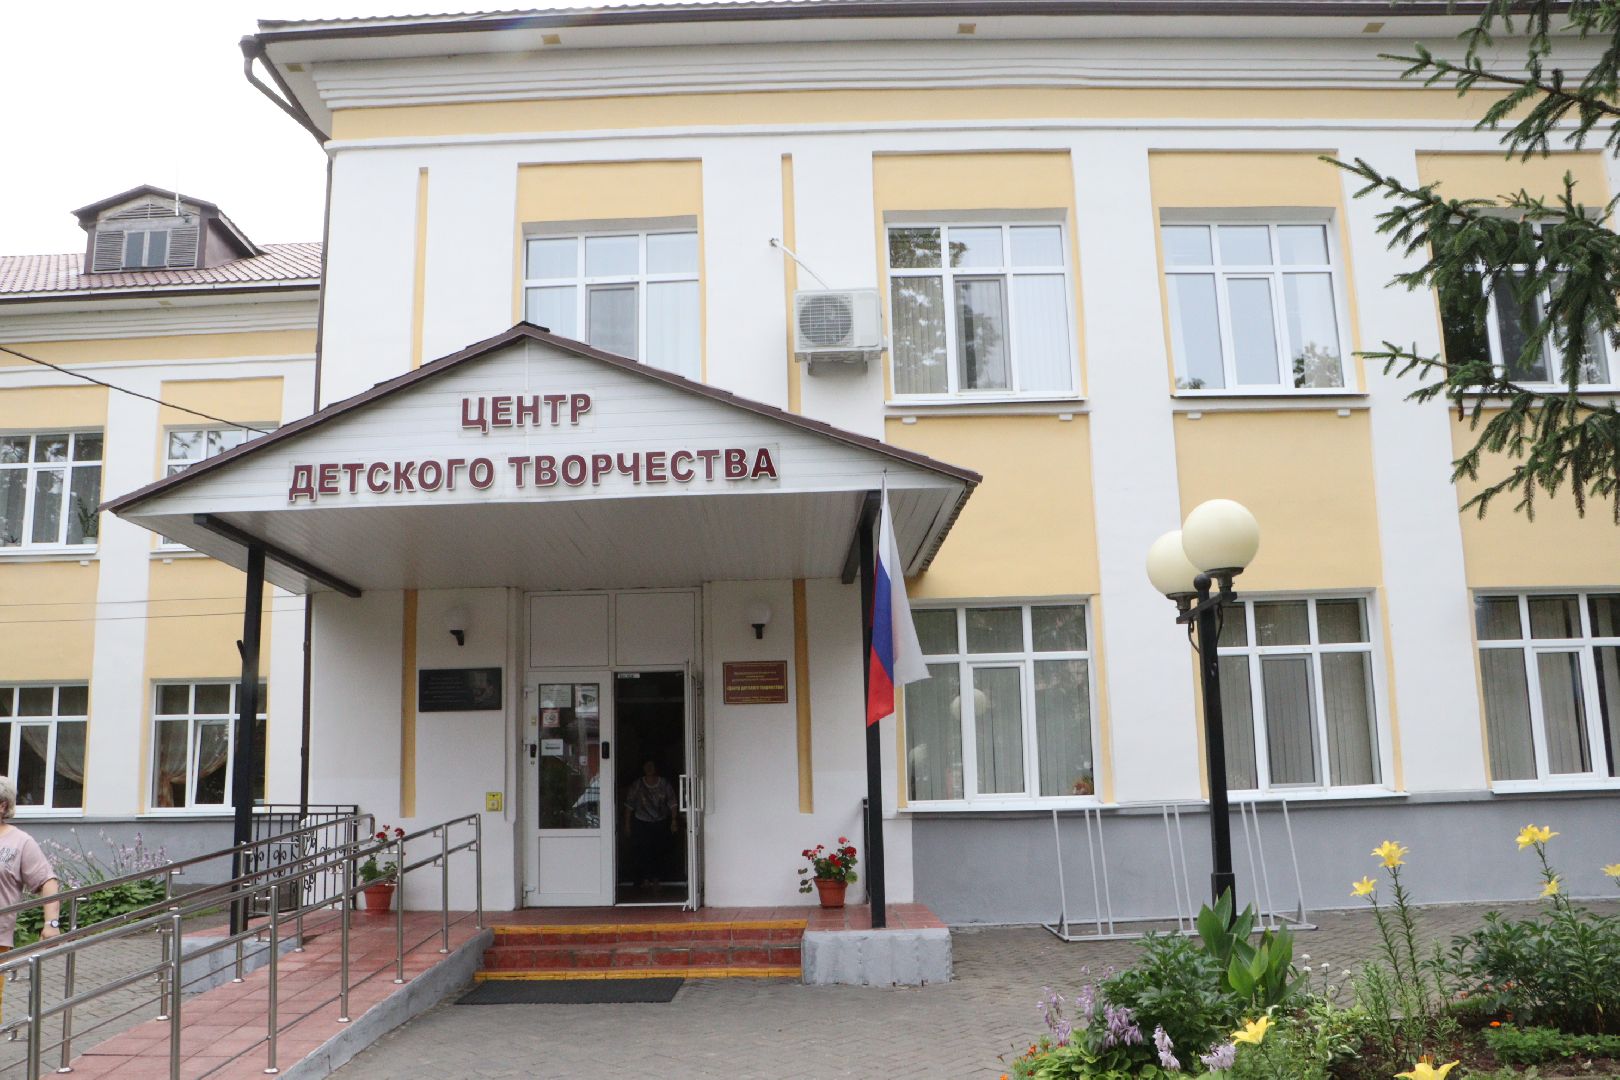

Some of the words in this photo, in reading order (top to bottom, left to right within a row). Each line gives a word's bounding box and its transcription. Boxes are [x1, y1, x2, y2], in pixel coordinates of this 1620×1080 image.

[461, 393, 592, 433] ЦЕНТР
[288, 457, 495, 502] ДЕТСКОГО
[508, 447, 778, 488] ТВОРЧЕСТВА
